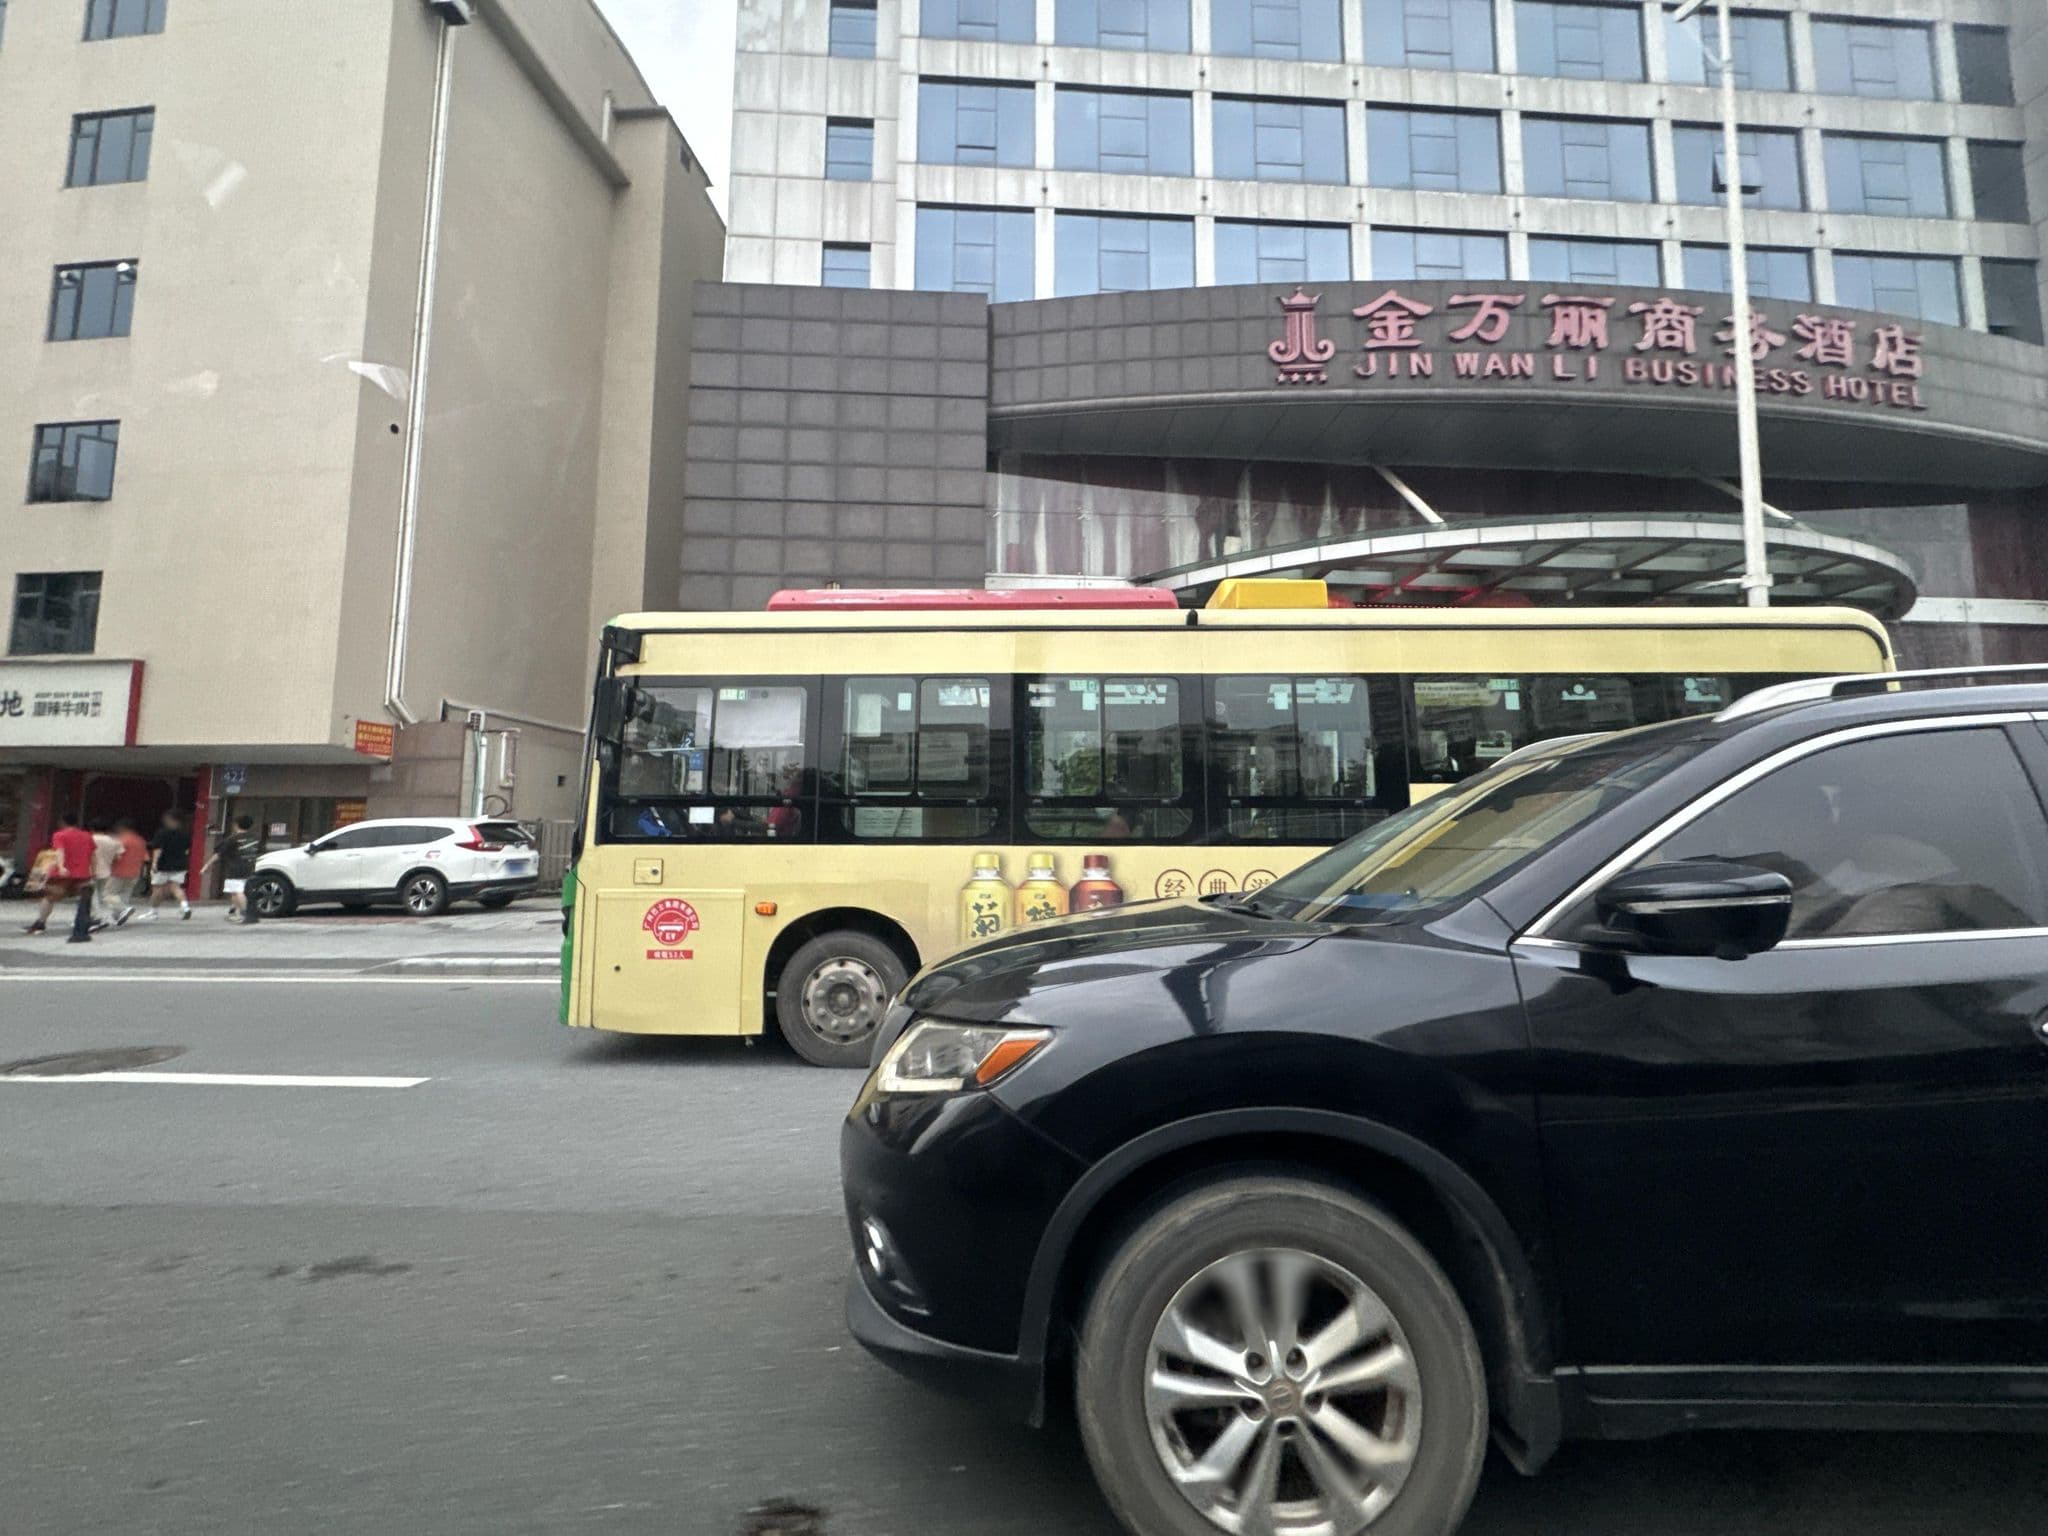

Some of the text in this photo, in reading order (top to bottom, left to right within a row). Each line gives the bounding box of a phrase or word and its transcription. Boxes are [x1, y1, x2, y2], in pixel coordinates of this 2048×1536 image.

[1352, 288, 1925, 379] 金万丽商务酒店
[1353, 351, 1929, 410] JIN WAN LI BUSINESS HOTEL
